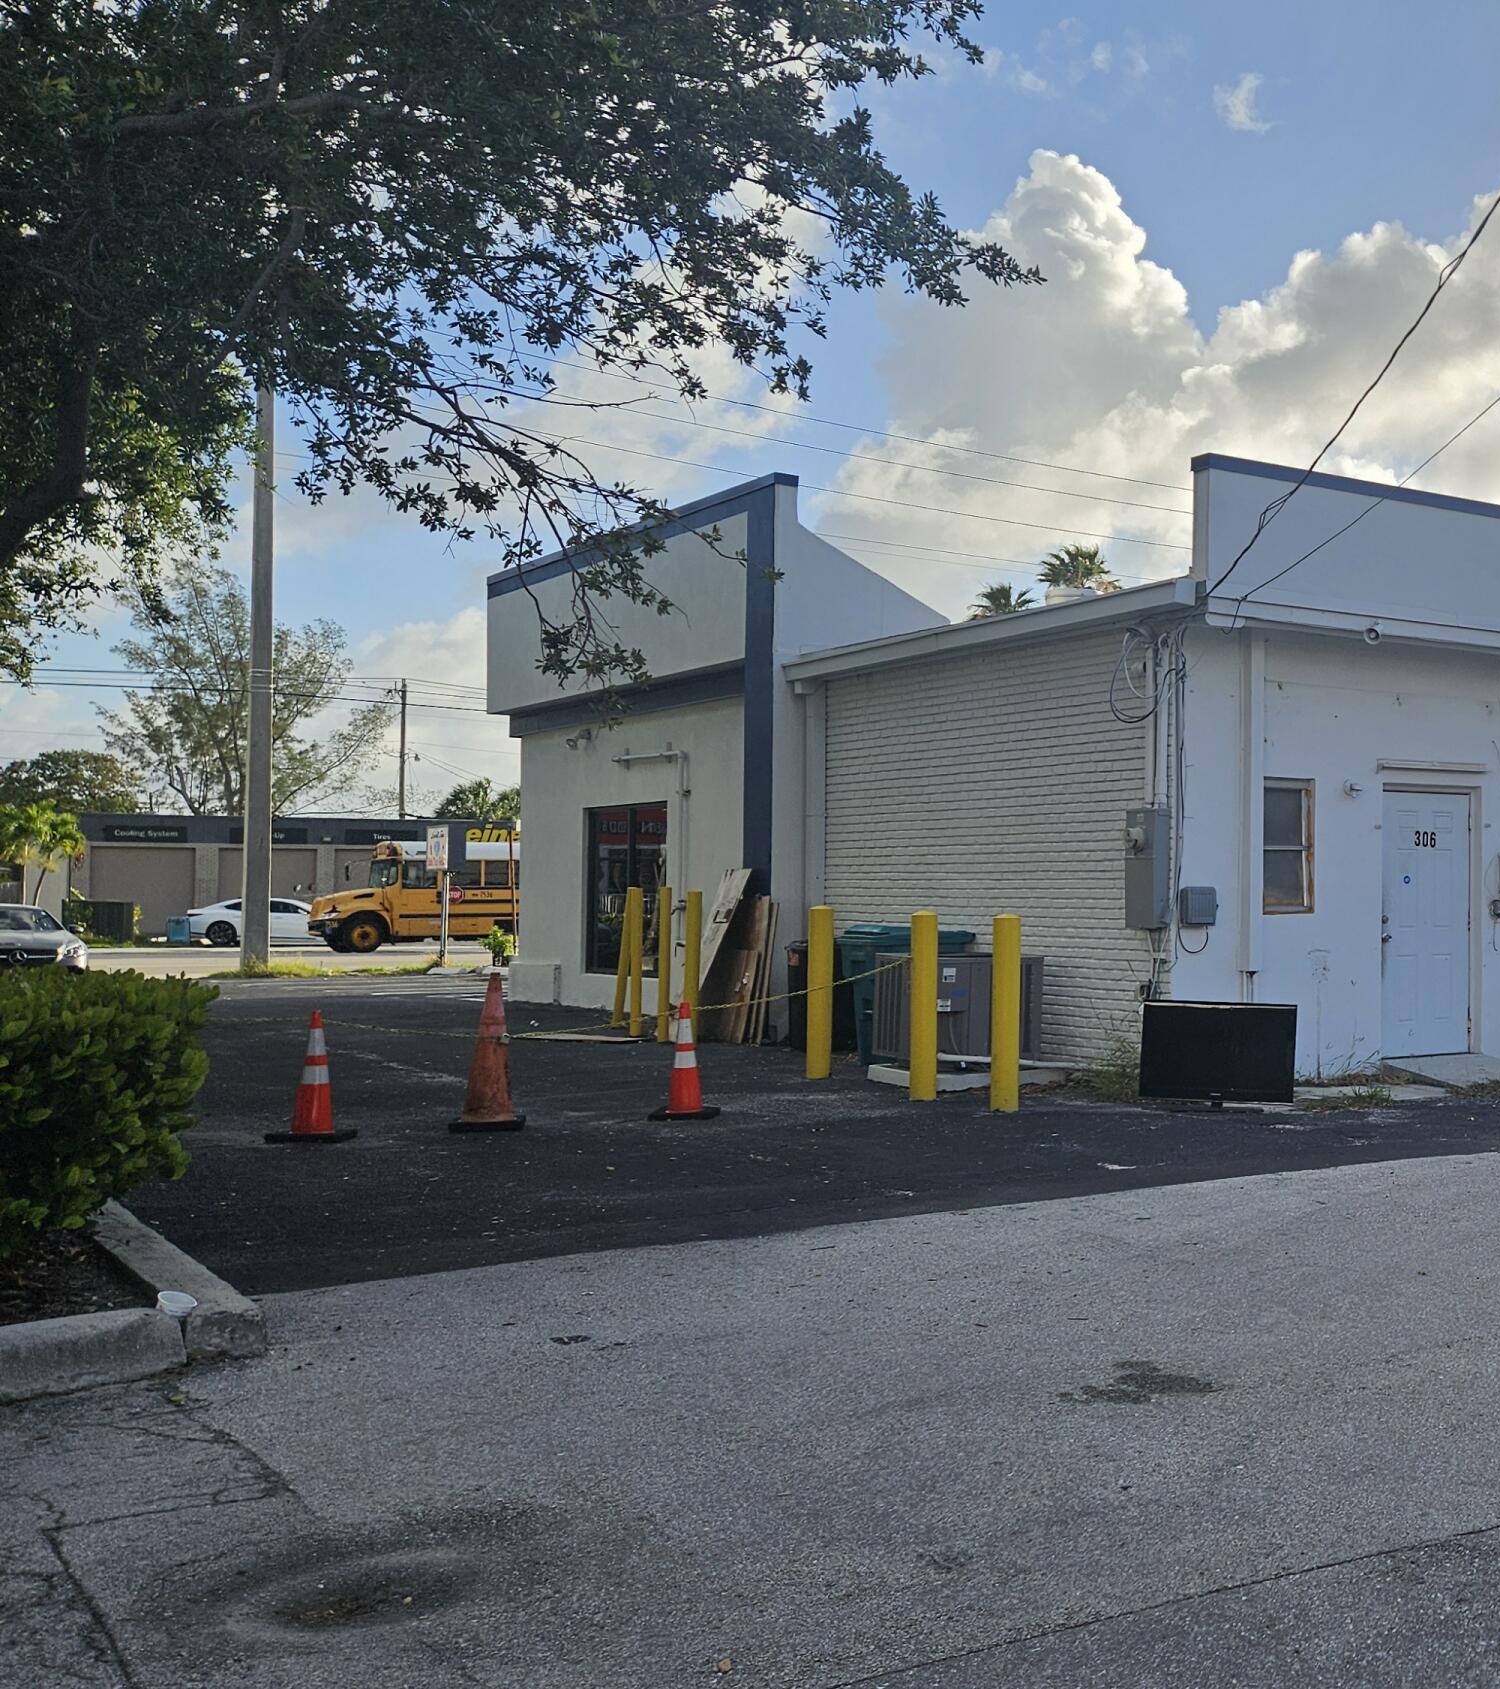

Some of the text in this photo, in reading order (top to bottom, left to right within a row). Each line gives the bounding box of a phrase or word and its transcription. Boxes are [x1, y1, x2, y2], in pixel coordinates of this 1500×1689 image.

[114, 829, 179, 838] Cooling System
[1414, 830, 1437, 848] 306
